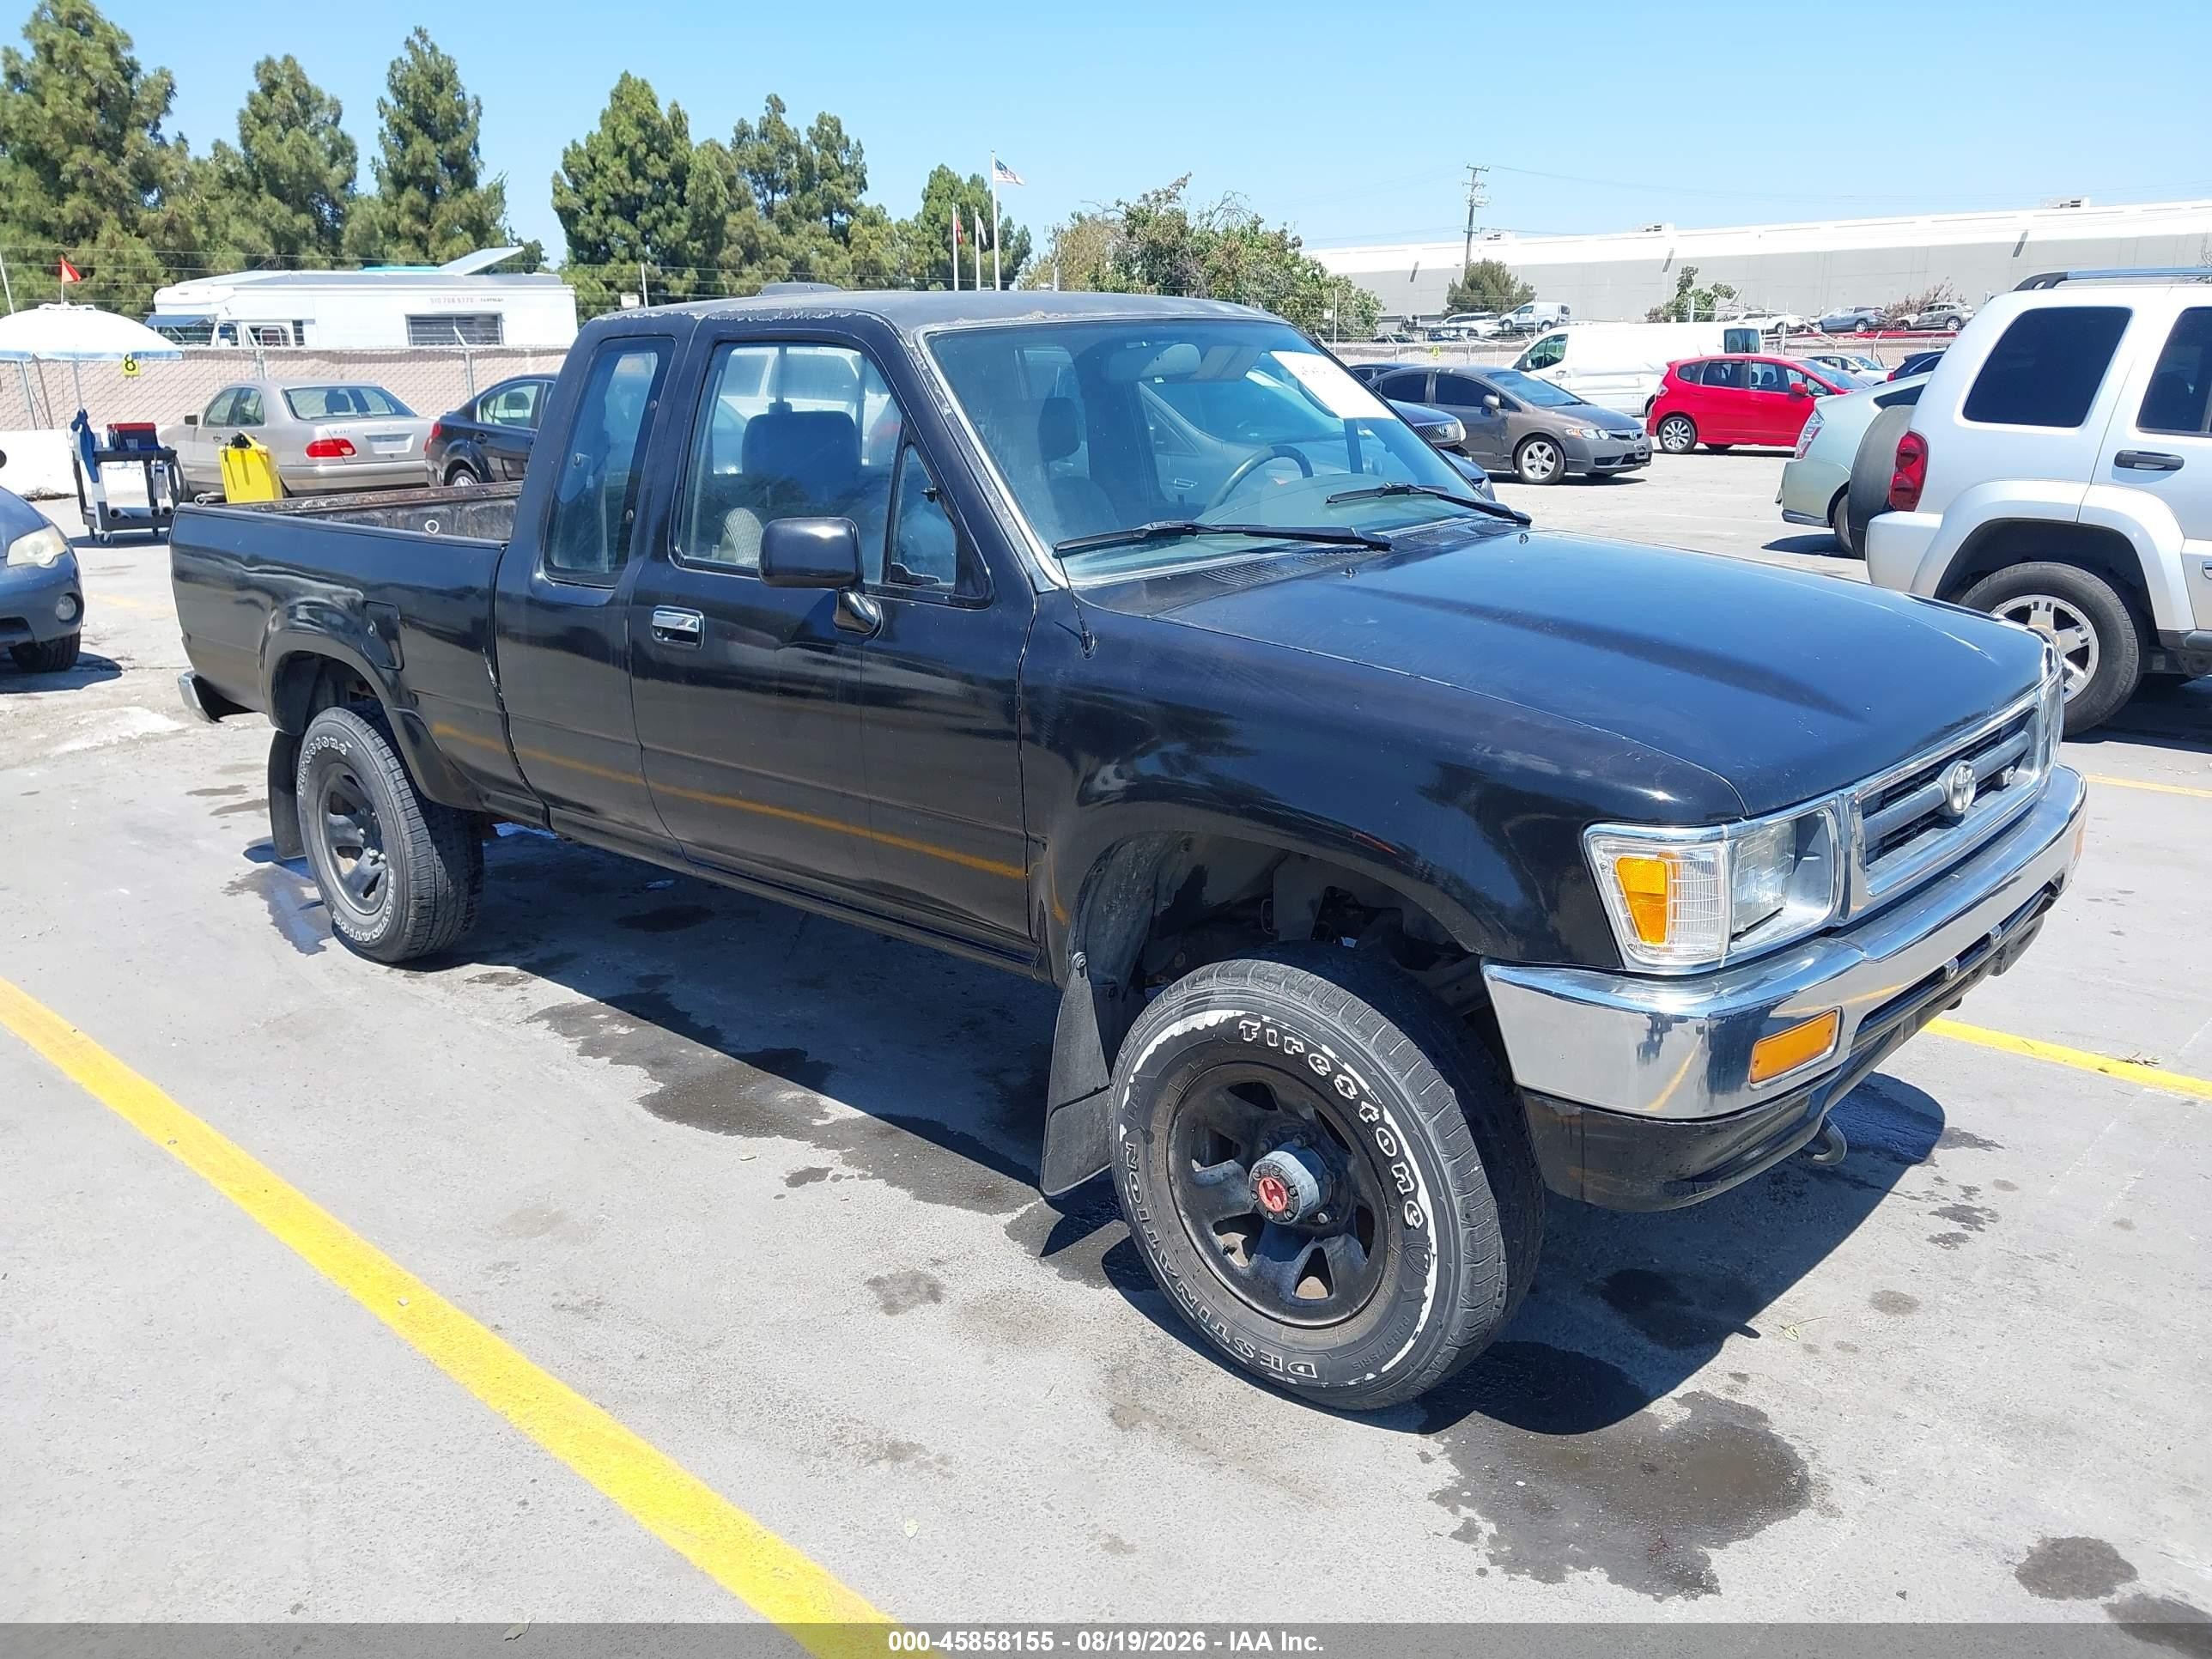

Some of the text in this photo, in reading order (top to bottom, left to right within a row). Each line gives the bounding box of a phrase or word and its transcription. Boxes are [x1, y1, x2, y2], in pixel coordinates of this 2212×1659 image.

[125, 353, 137, 372] 8
[1433, 347, 1438, 357] 3
[332, 867, 394, 942] DESTINATION
[1238, 1018, 1425, 1230] Firestone
[1124, 1140, 1319, 1380] DESTINATION
